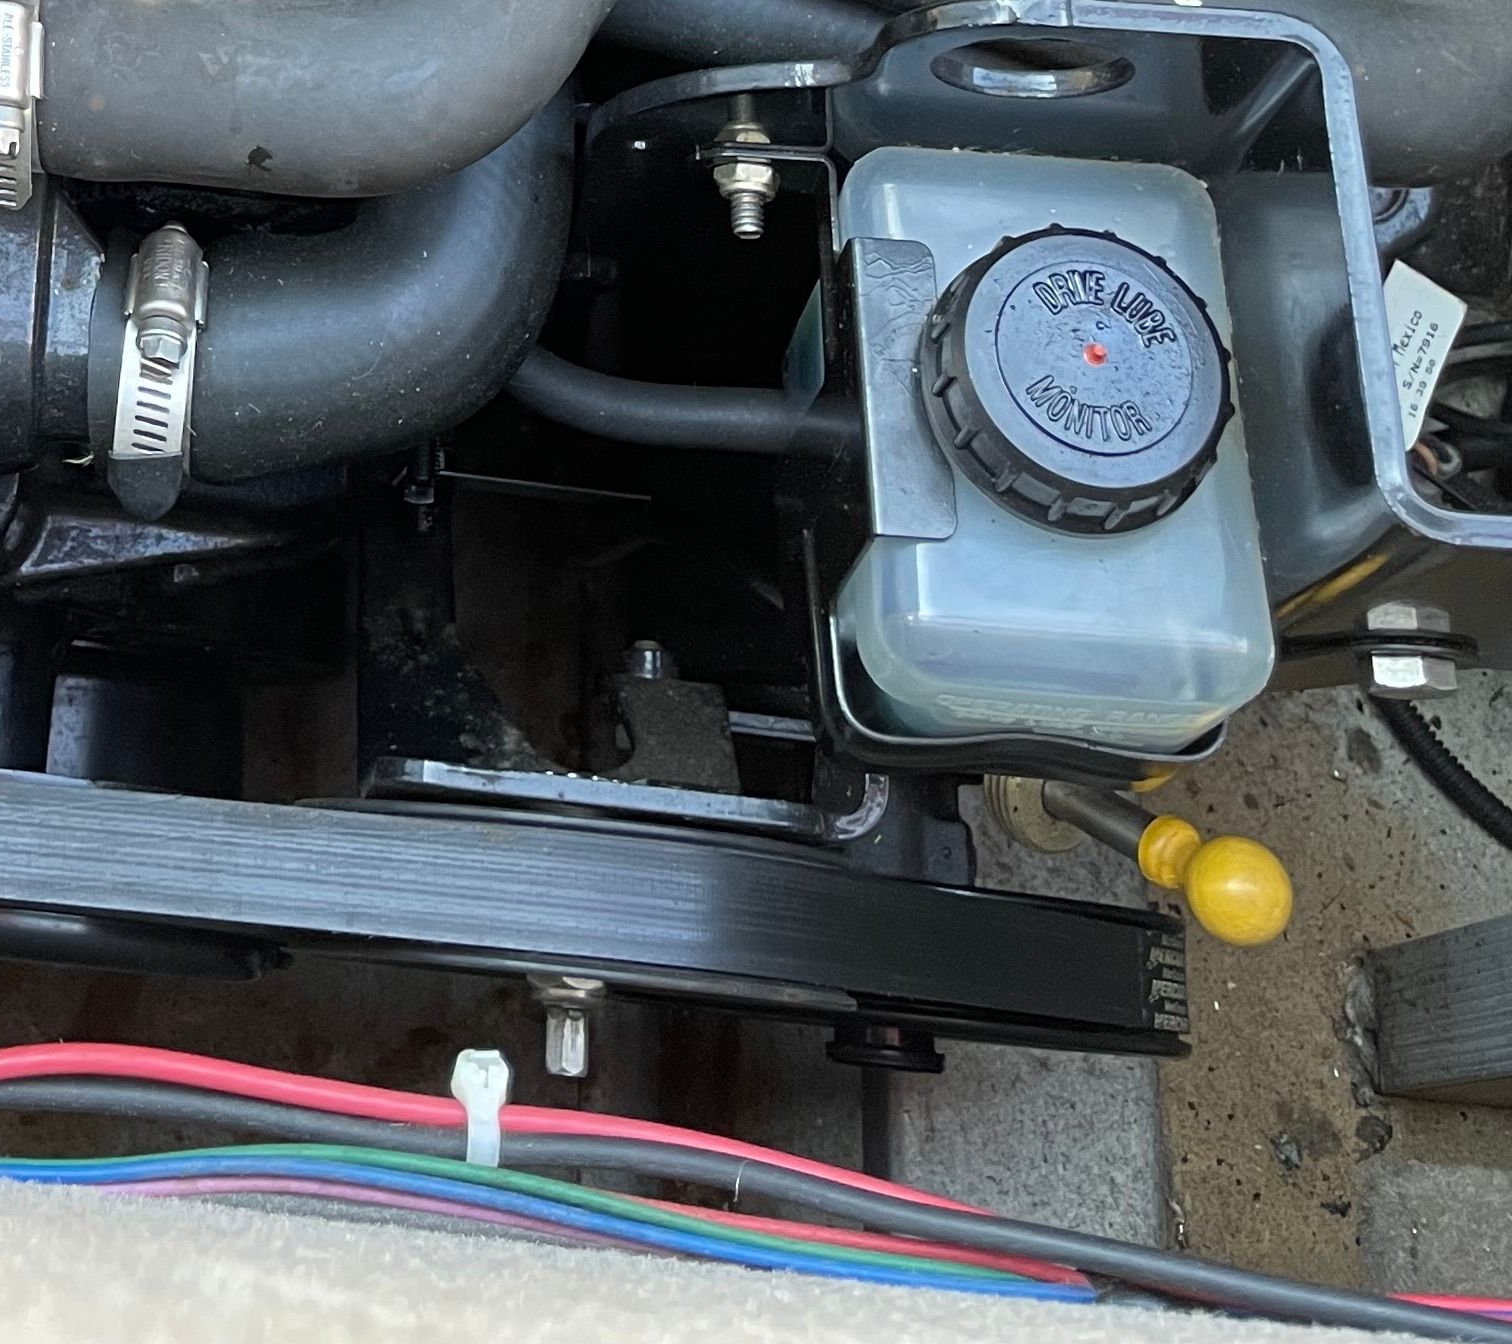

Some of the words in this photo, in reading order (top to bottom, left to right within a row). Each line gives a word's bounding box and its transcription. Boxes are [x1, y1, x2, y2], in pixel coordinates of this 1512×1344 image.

[1032, 269, 1107, 315] DRIVE
[1110, 281, 1176, 348] LUBE
[1025, 374, 1152, 442] MONITOR
